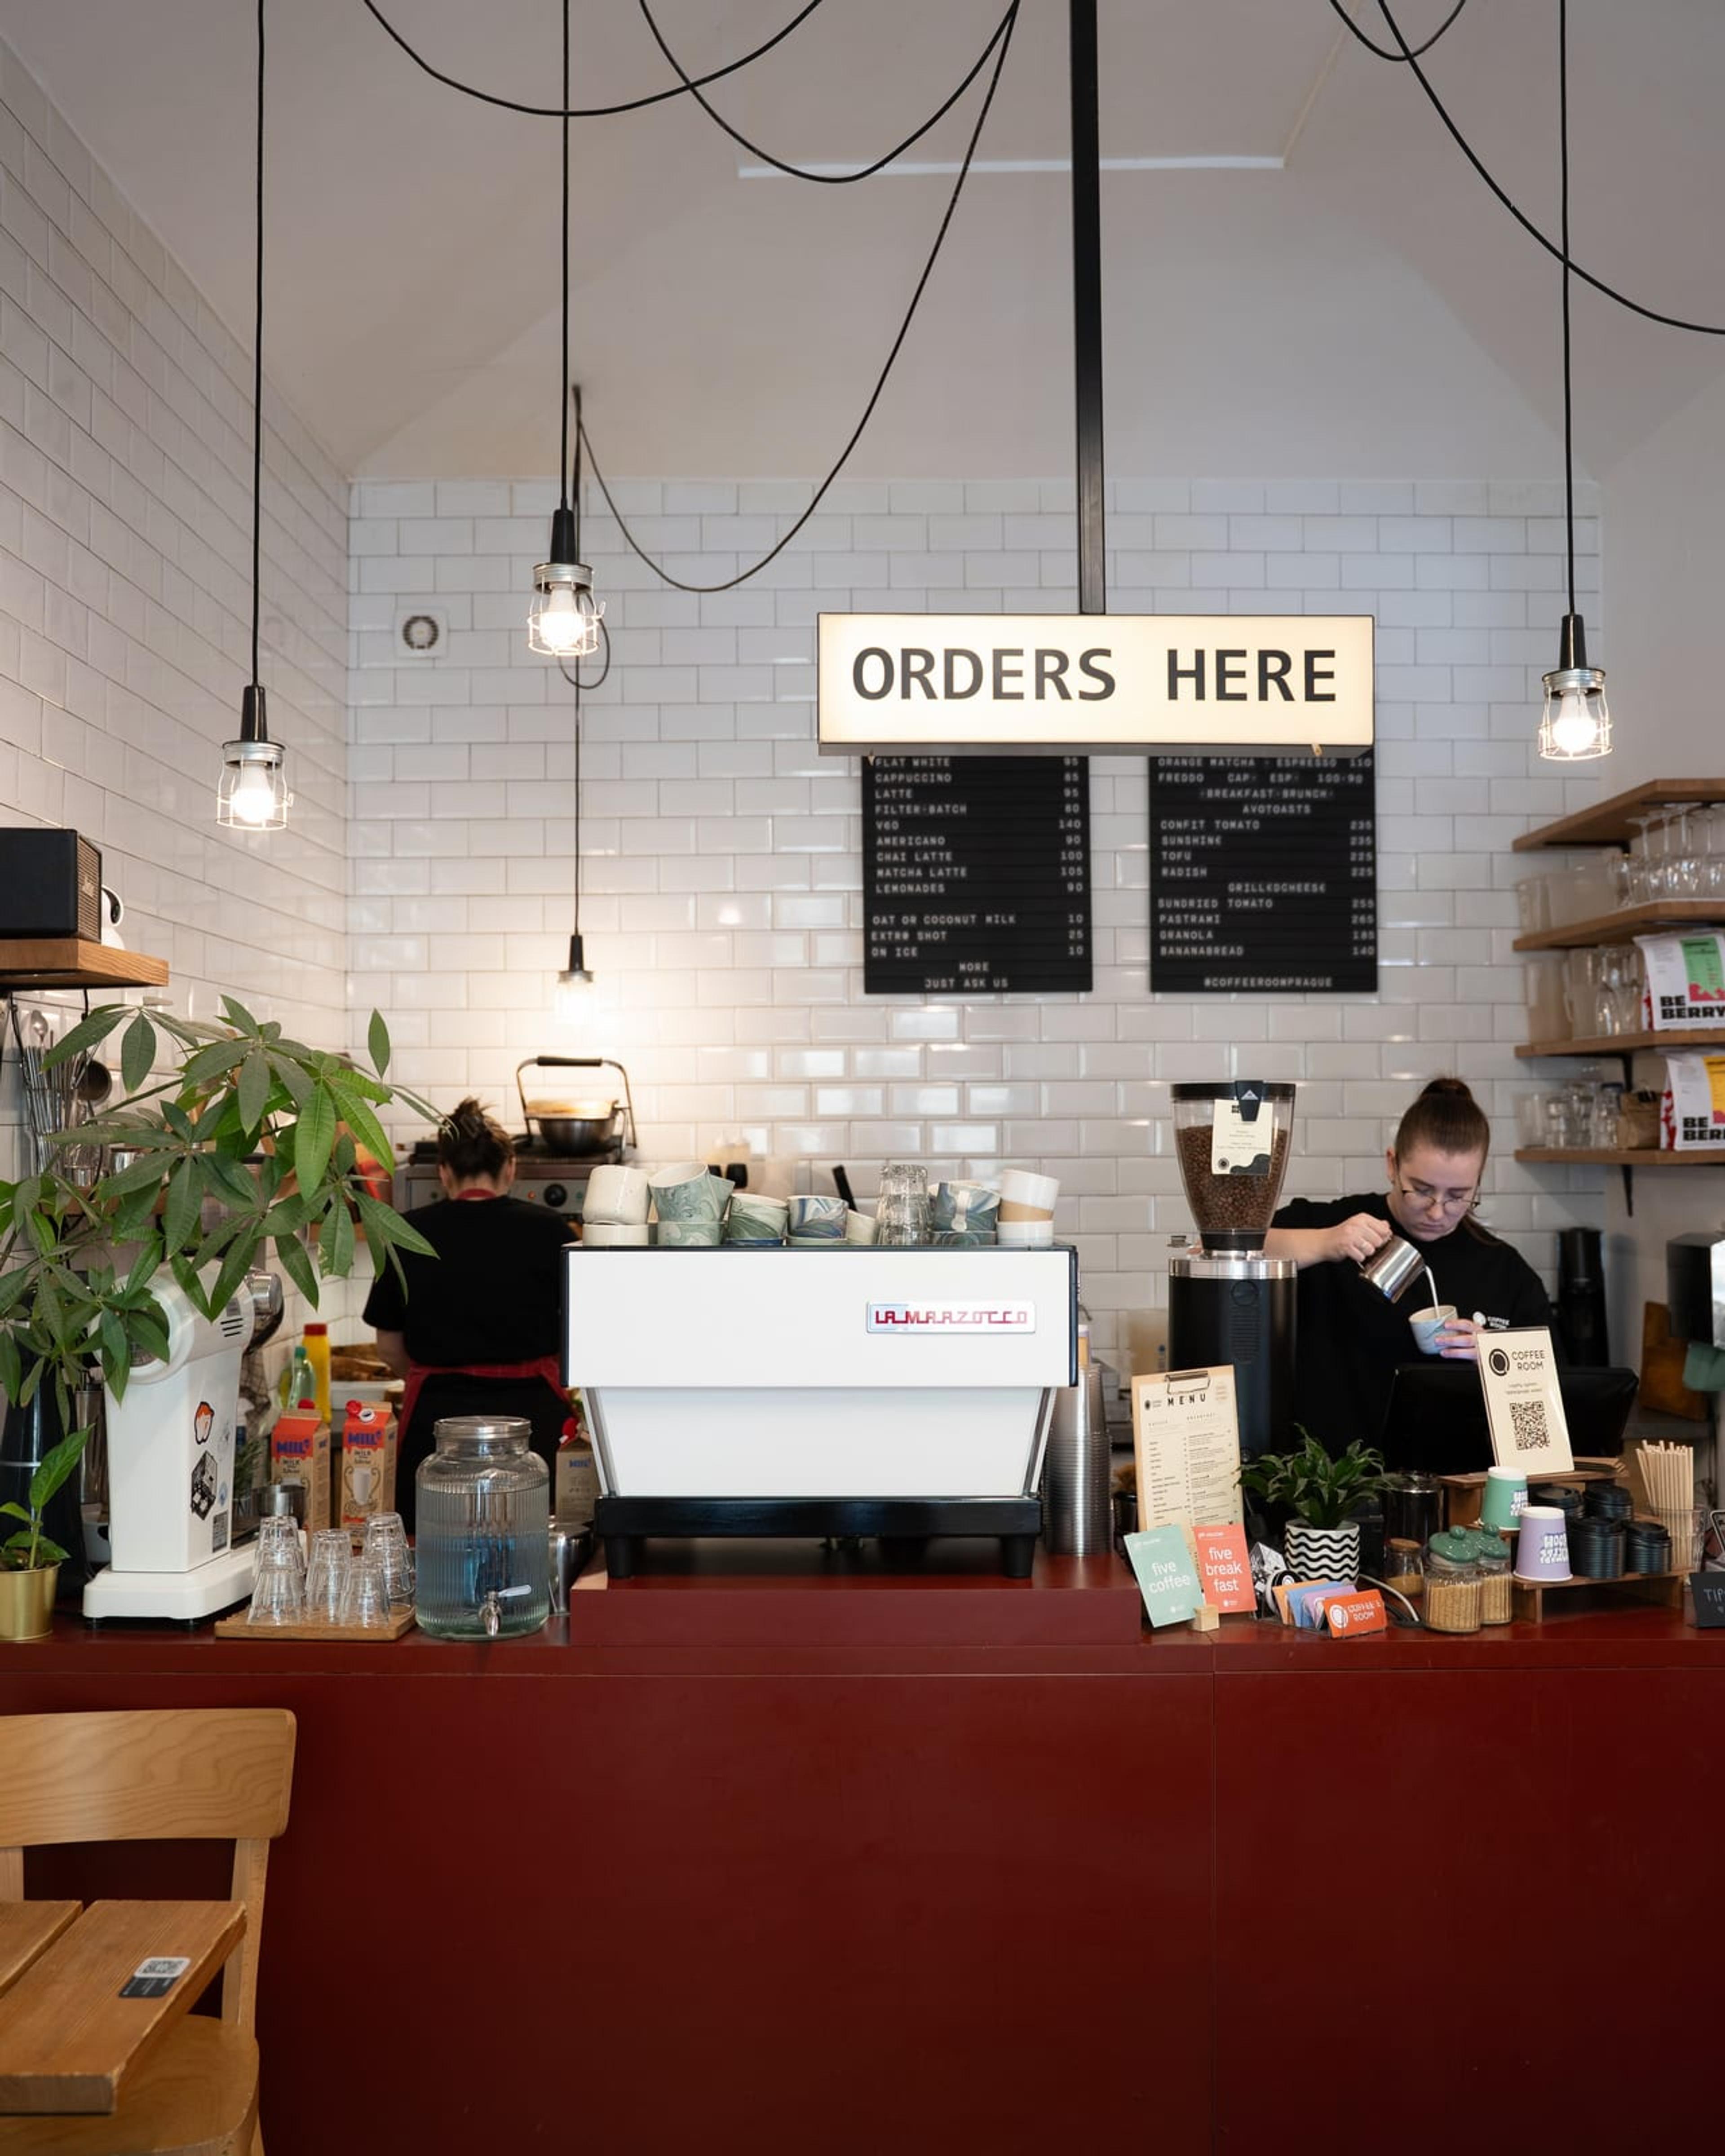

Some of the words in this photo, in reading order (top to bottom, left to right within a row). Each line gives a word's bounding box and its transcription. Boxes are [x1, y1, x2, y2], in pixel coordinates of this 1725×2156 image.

[853, 647, 1115, 701] ORDERS
[1168, 649, 1336, 702] HERE
[875, 773, 951, 782] CAPPUCCINO
[1161, 820, 1205, 830] CONFIT
[1215, 820, 1259, 829] TOMATO
[877, 836, 945, 845] AMERICANO
[877, 852, 906, 862] CHAI
[915, 852, 951, 862] LATTE
[1061, 851, 1083, 861] 100
[1162, 851, 1191, 861] TOFU
[877, 868, 922, 877] MATCHA
[930, 867, 966, 877] LATTE
[1162, 867, 1207, 877] RADISH
[876, 884, 944, 893] LEMONADES
[1158, 899, 1218, 908] SUNDRIED
[1228, 899, 1273, 908] TOMATO
[873, 915, 895, 925] OAT
[902, 915, 916, 925] OR
[924, 915, 976, 924] COCONUT
[986, 915, 1015, 923] MILK
[1069, 914, 1083, 923] 10
[1159, 915, 1219, 923] PASTRAMI
[917, 931, 947, 941] SHOT
[1160, 931, 1213, 940] GRANOLA
[872, 947, 886, 957] ON
[896, 947, 917, 957] ICE
[1069, 945, 1083, 955] 10
[1161, 946, 1243, 955] BANANABREAD
[960, 962, 988, 972] MORE
[925, 978, 955, 988] JUST
[964, 979, 985, 988] ASK
[1660, 995, 1686, 1007] BE
[1683, 1117, 1708, 1128] BE
[1683, 1129, 1725, 1140] BER
[1512, 1349, 1545, 1361] COFFEE
[1517, 1361, 1543, 1371] ROOM
[1208, 1545, 1233, 1561] five
[1152, 1561, 1177, 1576] five
[1205, 1563, 1243, 1577] break
[1149, 1574, 1191, 1595] coffee
[1213, 1578, 1240, 1592] fast
